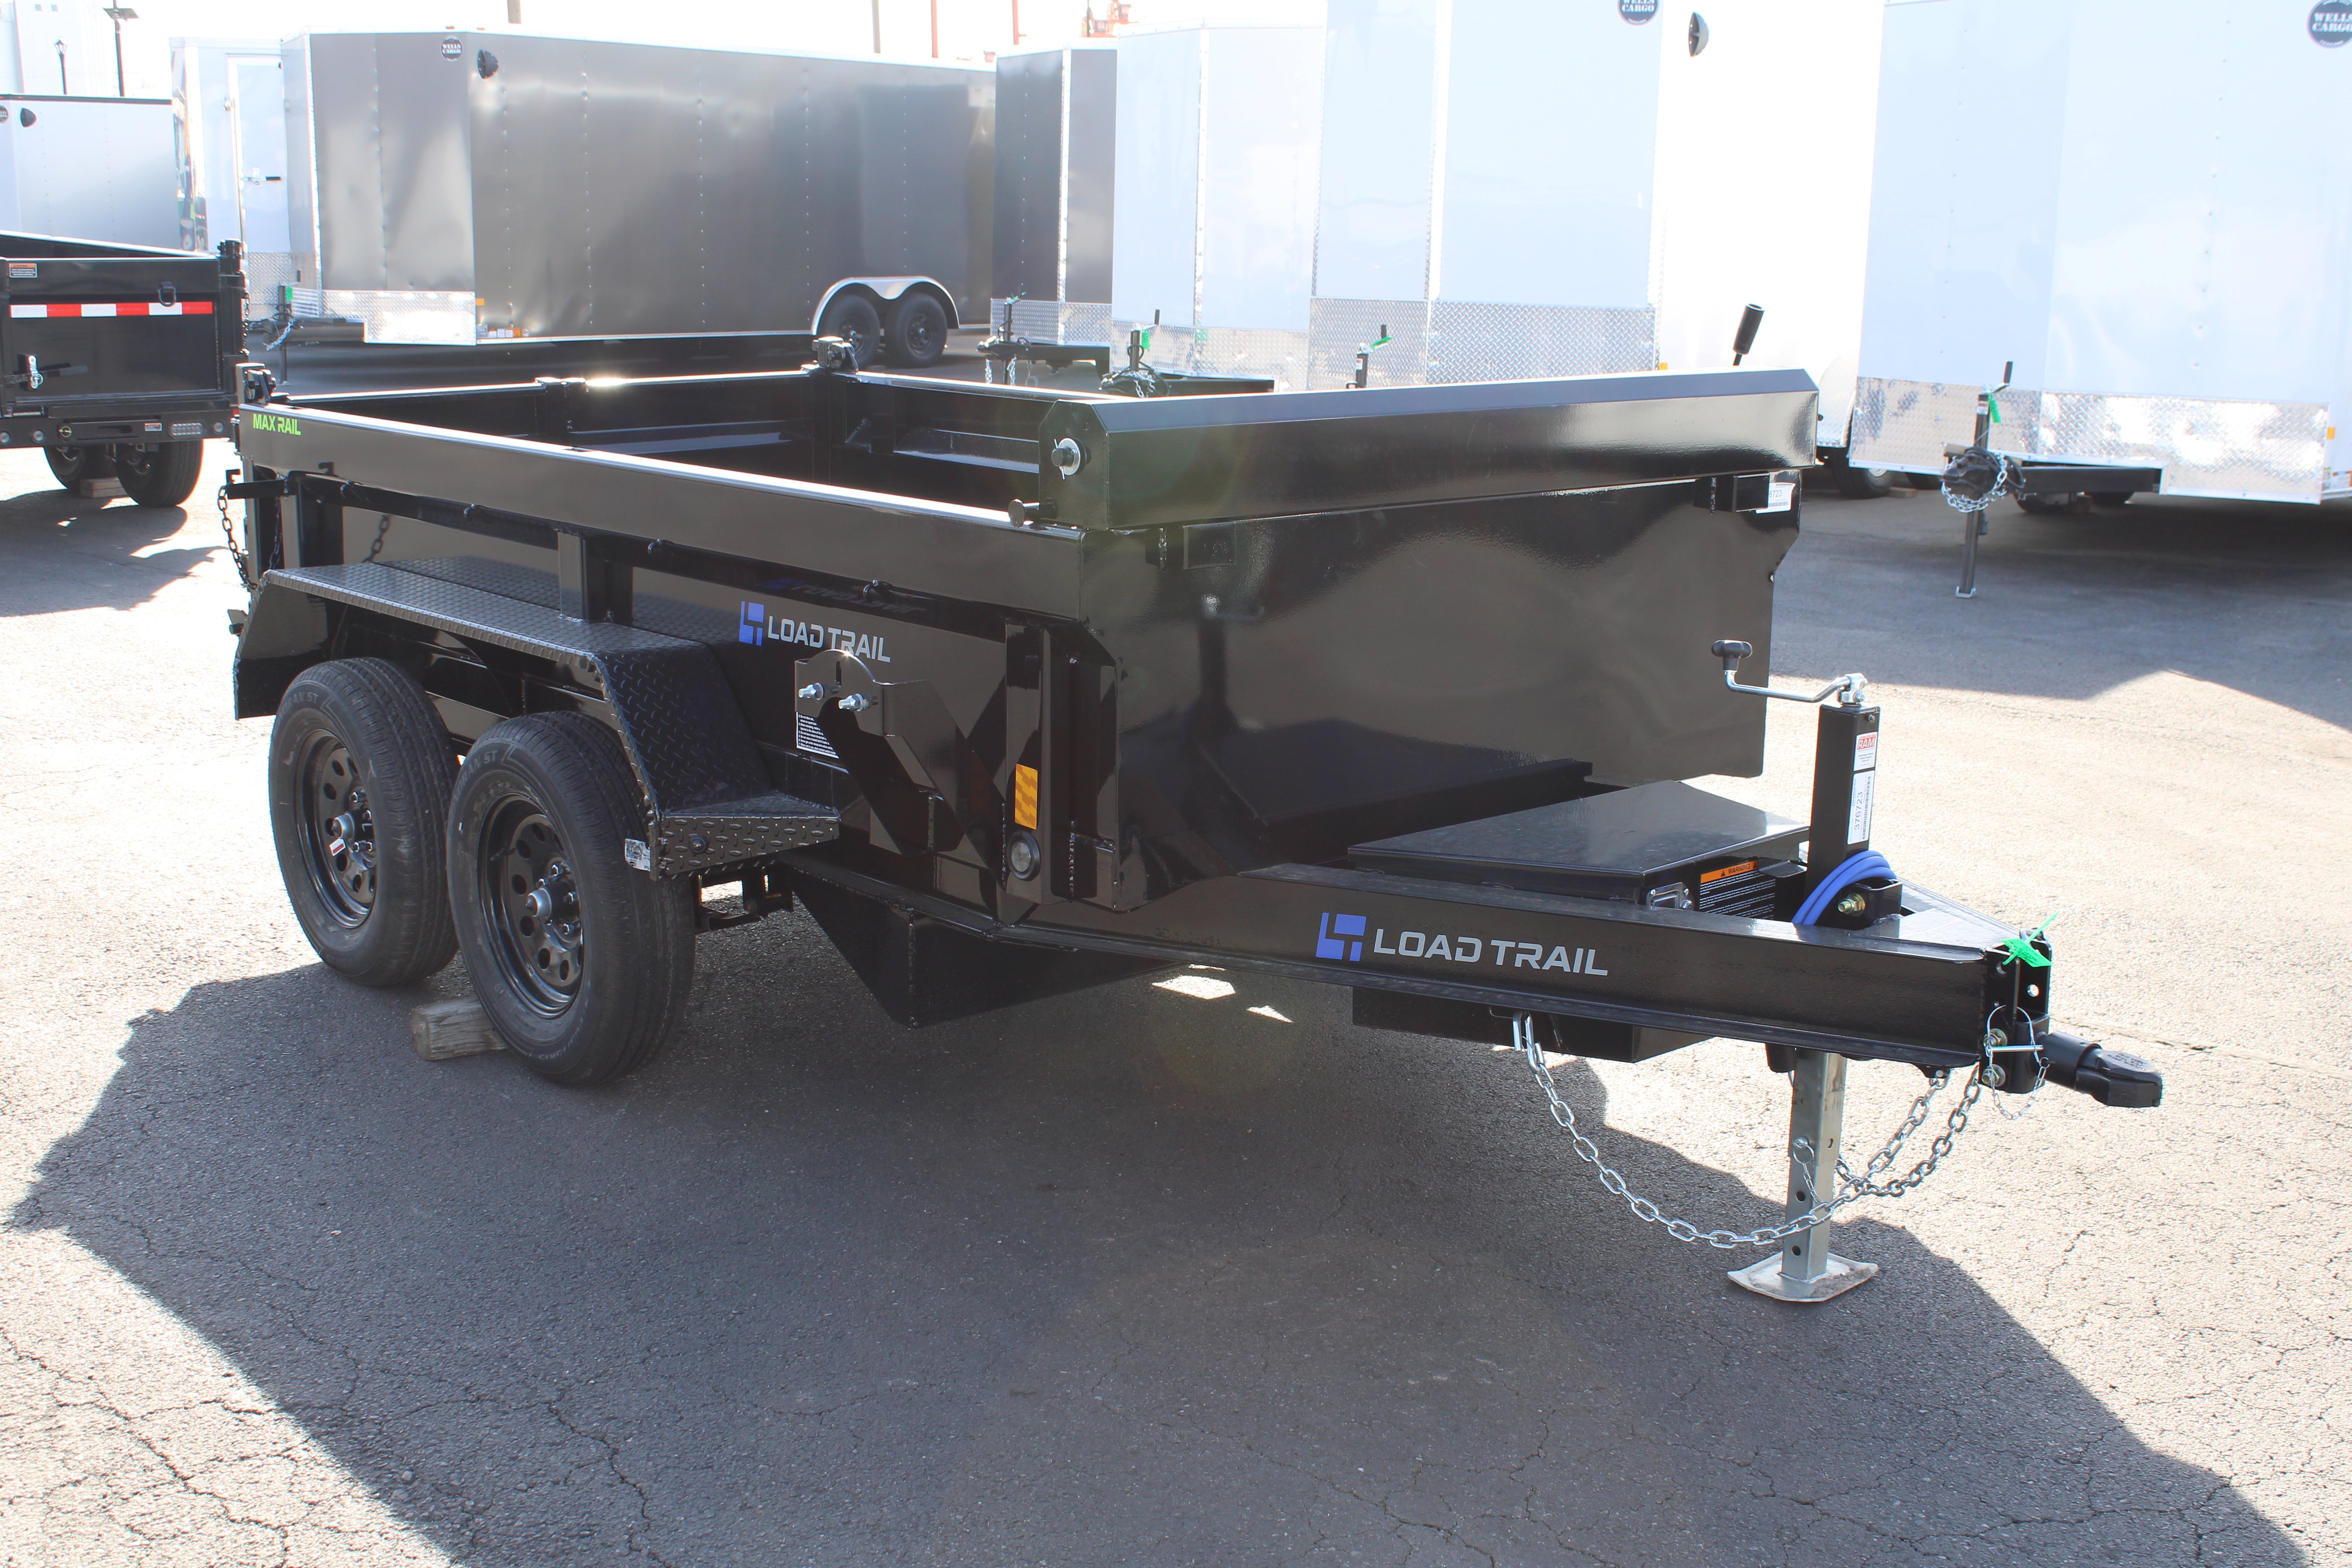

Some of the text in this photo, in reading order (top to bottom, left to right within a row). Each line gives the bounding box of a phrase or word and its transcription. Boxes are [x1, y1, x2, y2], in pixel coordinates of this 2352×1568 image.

[1621, 4, 1655, 12] CARGO
[253, 413, 301, 436] MAX RAIL
[768, 616, 891, 663] LOAD TRAIL
[1858, 737, 1875, 749] RAM
[1854, 791, 1863, 831] 376723
[1728, 863, 1751, 874] WARNING
[1374, 928, 1608, 976] LOAD TRAIL
